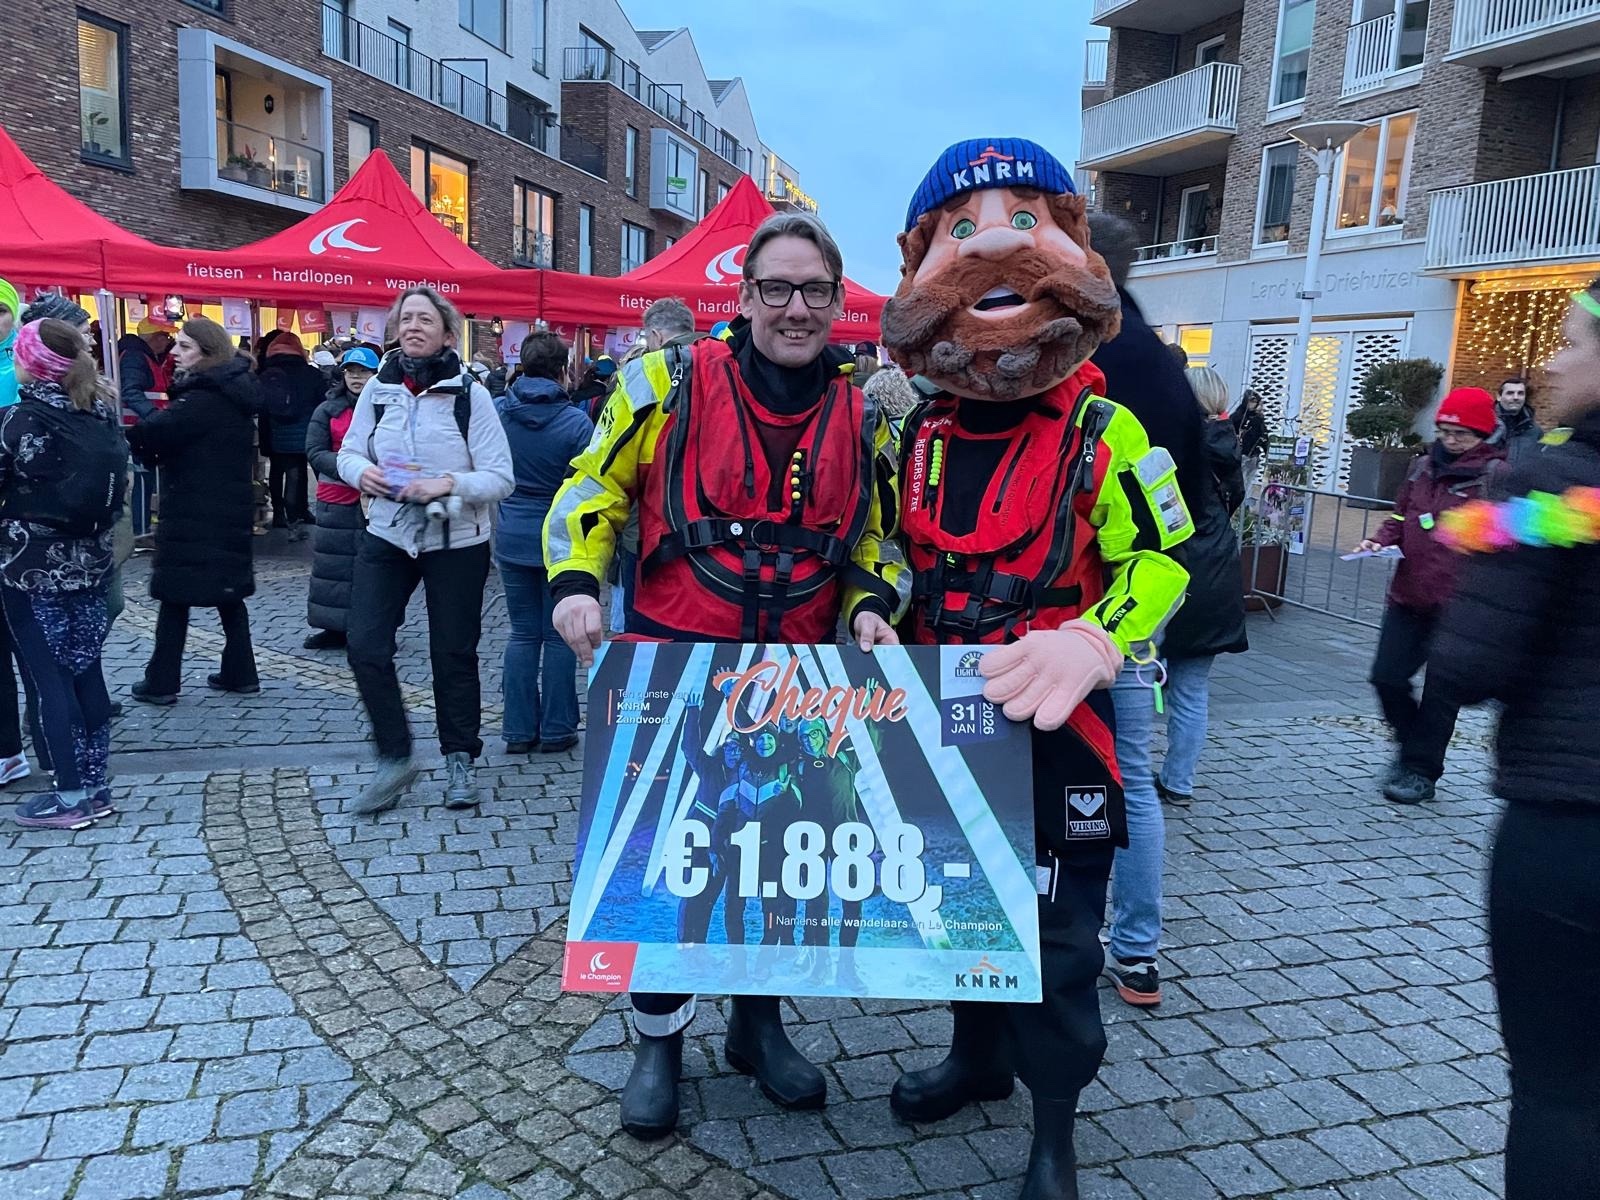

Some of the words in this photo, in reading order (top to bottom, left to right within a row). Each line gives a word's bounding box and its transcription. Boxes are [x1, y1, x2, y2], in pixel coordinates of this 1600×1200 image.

[953, 160, 1034, 190] KNRM
[186, 263, 244, 279] fietsen
[272, 267, 353, 286] hardlopen
[1251, 277, 1289, 299] Land
[839, 309, 869, 323] elen
[913, 438, 927, 481] REDDERS
[912, 481, 921, 495] OP
[910, 496, 919, 513] ZEE
[956, 668, 975, 677] LIGHT
[618, 689, 634, 698] Ten
[637, 690, 669, 701] gunste
[617, 702, 650, 711] KNRM
[712, 655, 909, 759] Cheque
[951, 703, 975, 721] 31
[616, 715, 670, 724] Zandvoort
[982, 702, 995, 735] 2026
[951, 723, 976, 734] JAN
[1070, 821, 1106, 831] VIKING
[664, 819, 711, 898] €
[730, 820, 971, 912] 1.888,-
[776, 915, 818, 926] Namens
[821, 917, 841, 927] alle
[843, 919, 908, 929] wandelaars
[944, 920, 1003, 932] Champion
[587, 973, 621, 981] Champion
[955, 973, 1018, 989] KNRM
